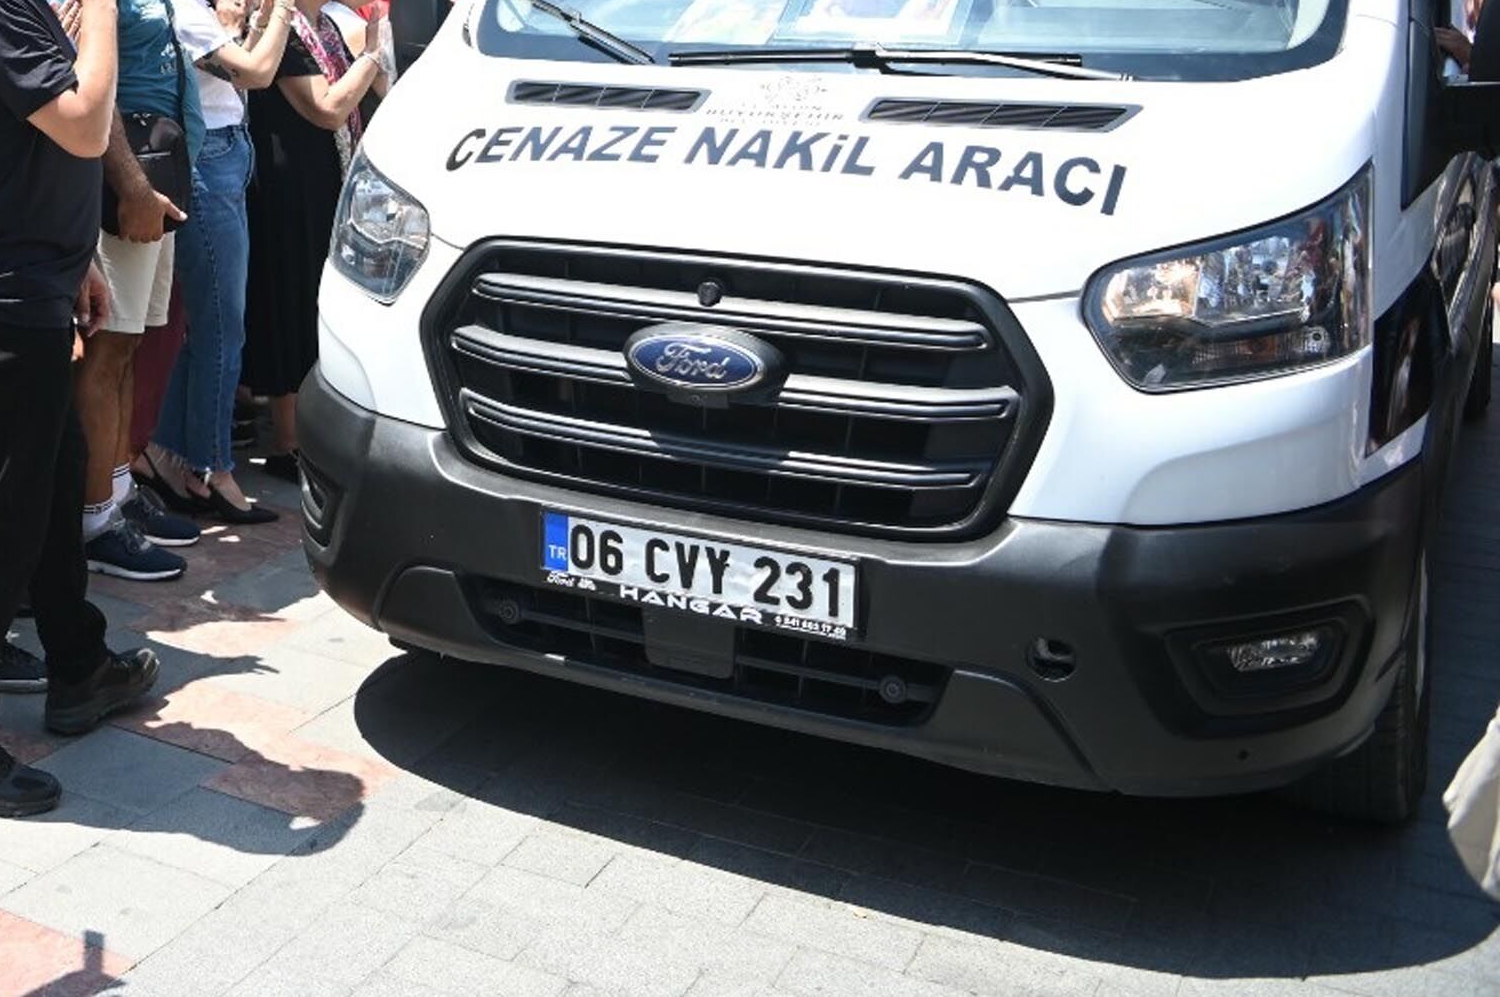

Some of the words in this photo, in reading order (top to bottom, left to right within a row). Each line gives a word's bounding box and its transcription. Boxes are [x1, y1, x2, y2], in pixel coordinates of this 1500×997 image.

[445, 125, 678, 172] CENAZE
[898, 140, 1129, 216] ARACI
[655, 342, 731, 380] Ford
[548, 544, 567, 561] TR
[570, 523, 624, 576] 06
[644, 538, 731, 595] CVY
[753, 556, 840, 617] 231
[619, 584, 765, 626] HANGAR
